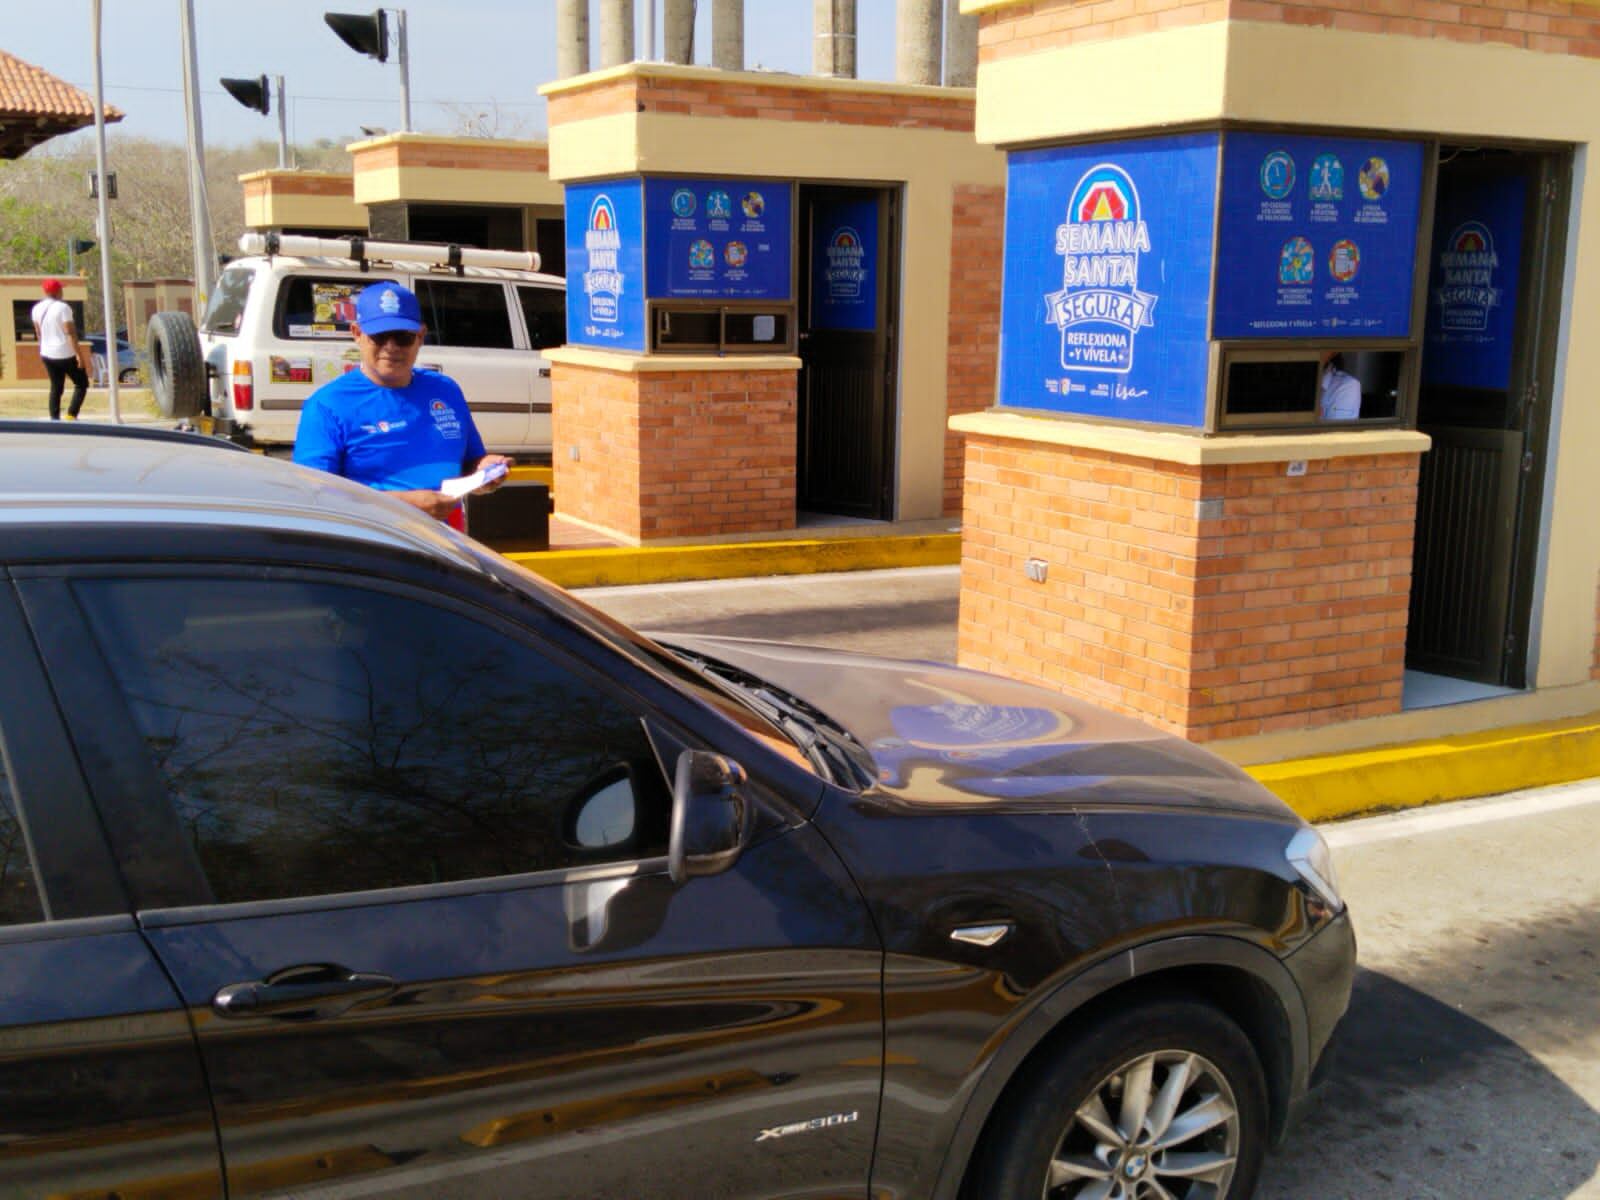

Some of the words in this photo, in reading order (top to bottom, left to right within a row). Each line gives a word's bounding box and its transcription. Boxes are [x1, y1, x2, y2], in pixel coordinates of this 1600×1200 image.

[1056, 222, 1150, 254] SEMANA
[1065, 256, 1135, 286] SANTA
[1062, 294, 1134, 329] SEGURA
[1067, 332, 1127, 348] REFLEXIONA
